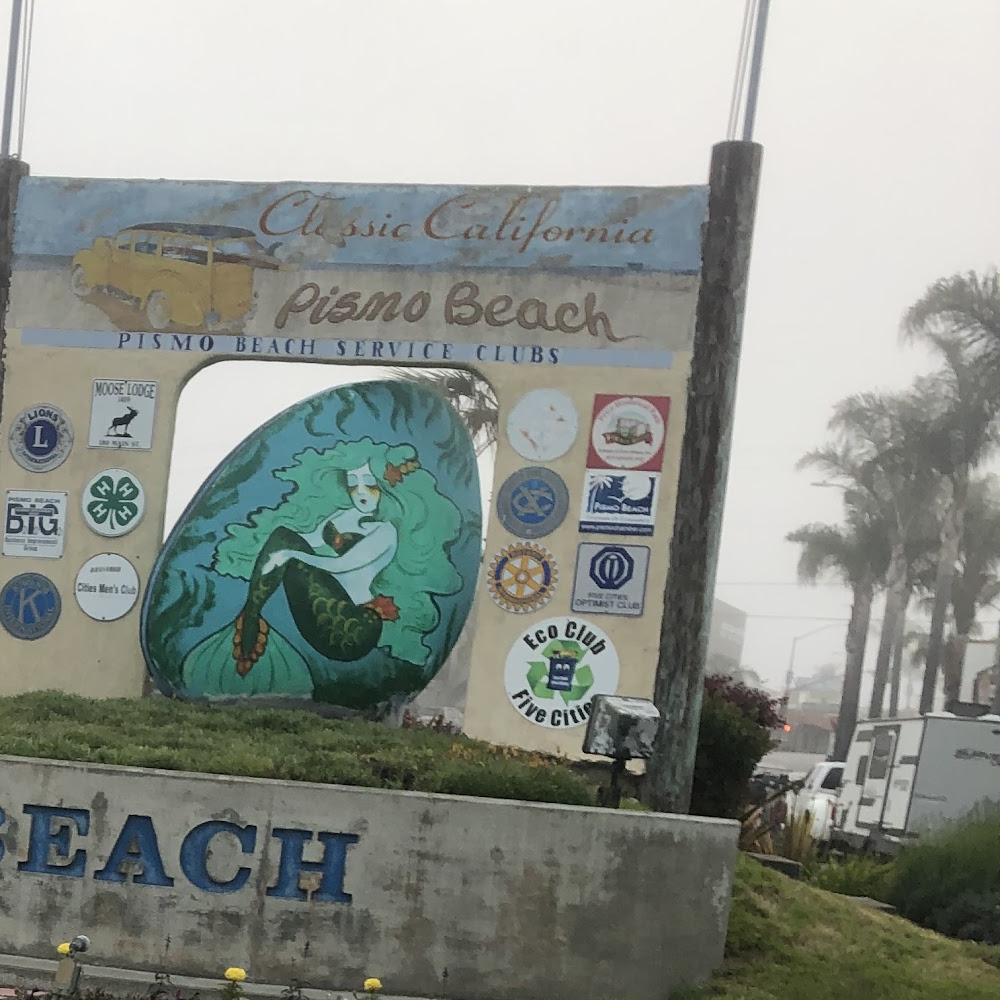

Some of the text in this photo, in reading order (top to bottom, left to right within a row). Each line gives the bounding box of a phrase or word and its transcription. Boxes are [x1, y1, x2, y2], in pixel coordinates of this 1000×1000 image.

[424, 192, 654, 253] California
[274, 281, 646, 342] Pismo Beach
[118, 333, 559, 364] PISMO BEACH SERVICE CLUBS
[94, 382, 155, 399] MOOSE LODGE
[28, 409, 58, 422] LIONS
[32, 425, 48, 447] L
[78, 583, 136, 594] Cities Men's Club
[617, 601, 640, 609] CLUB
[565, 621, 607, 655] Club
[512, 689, 547, 723] Five
